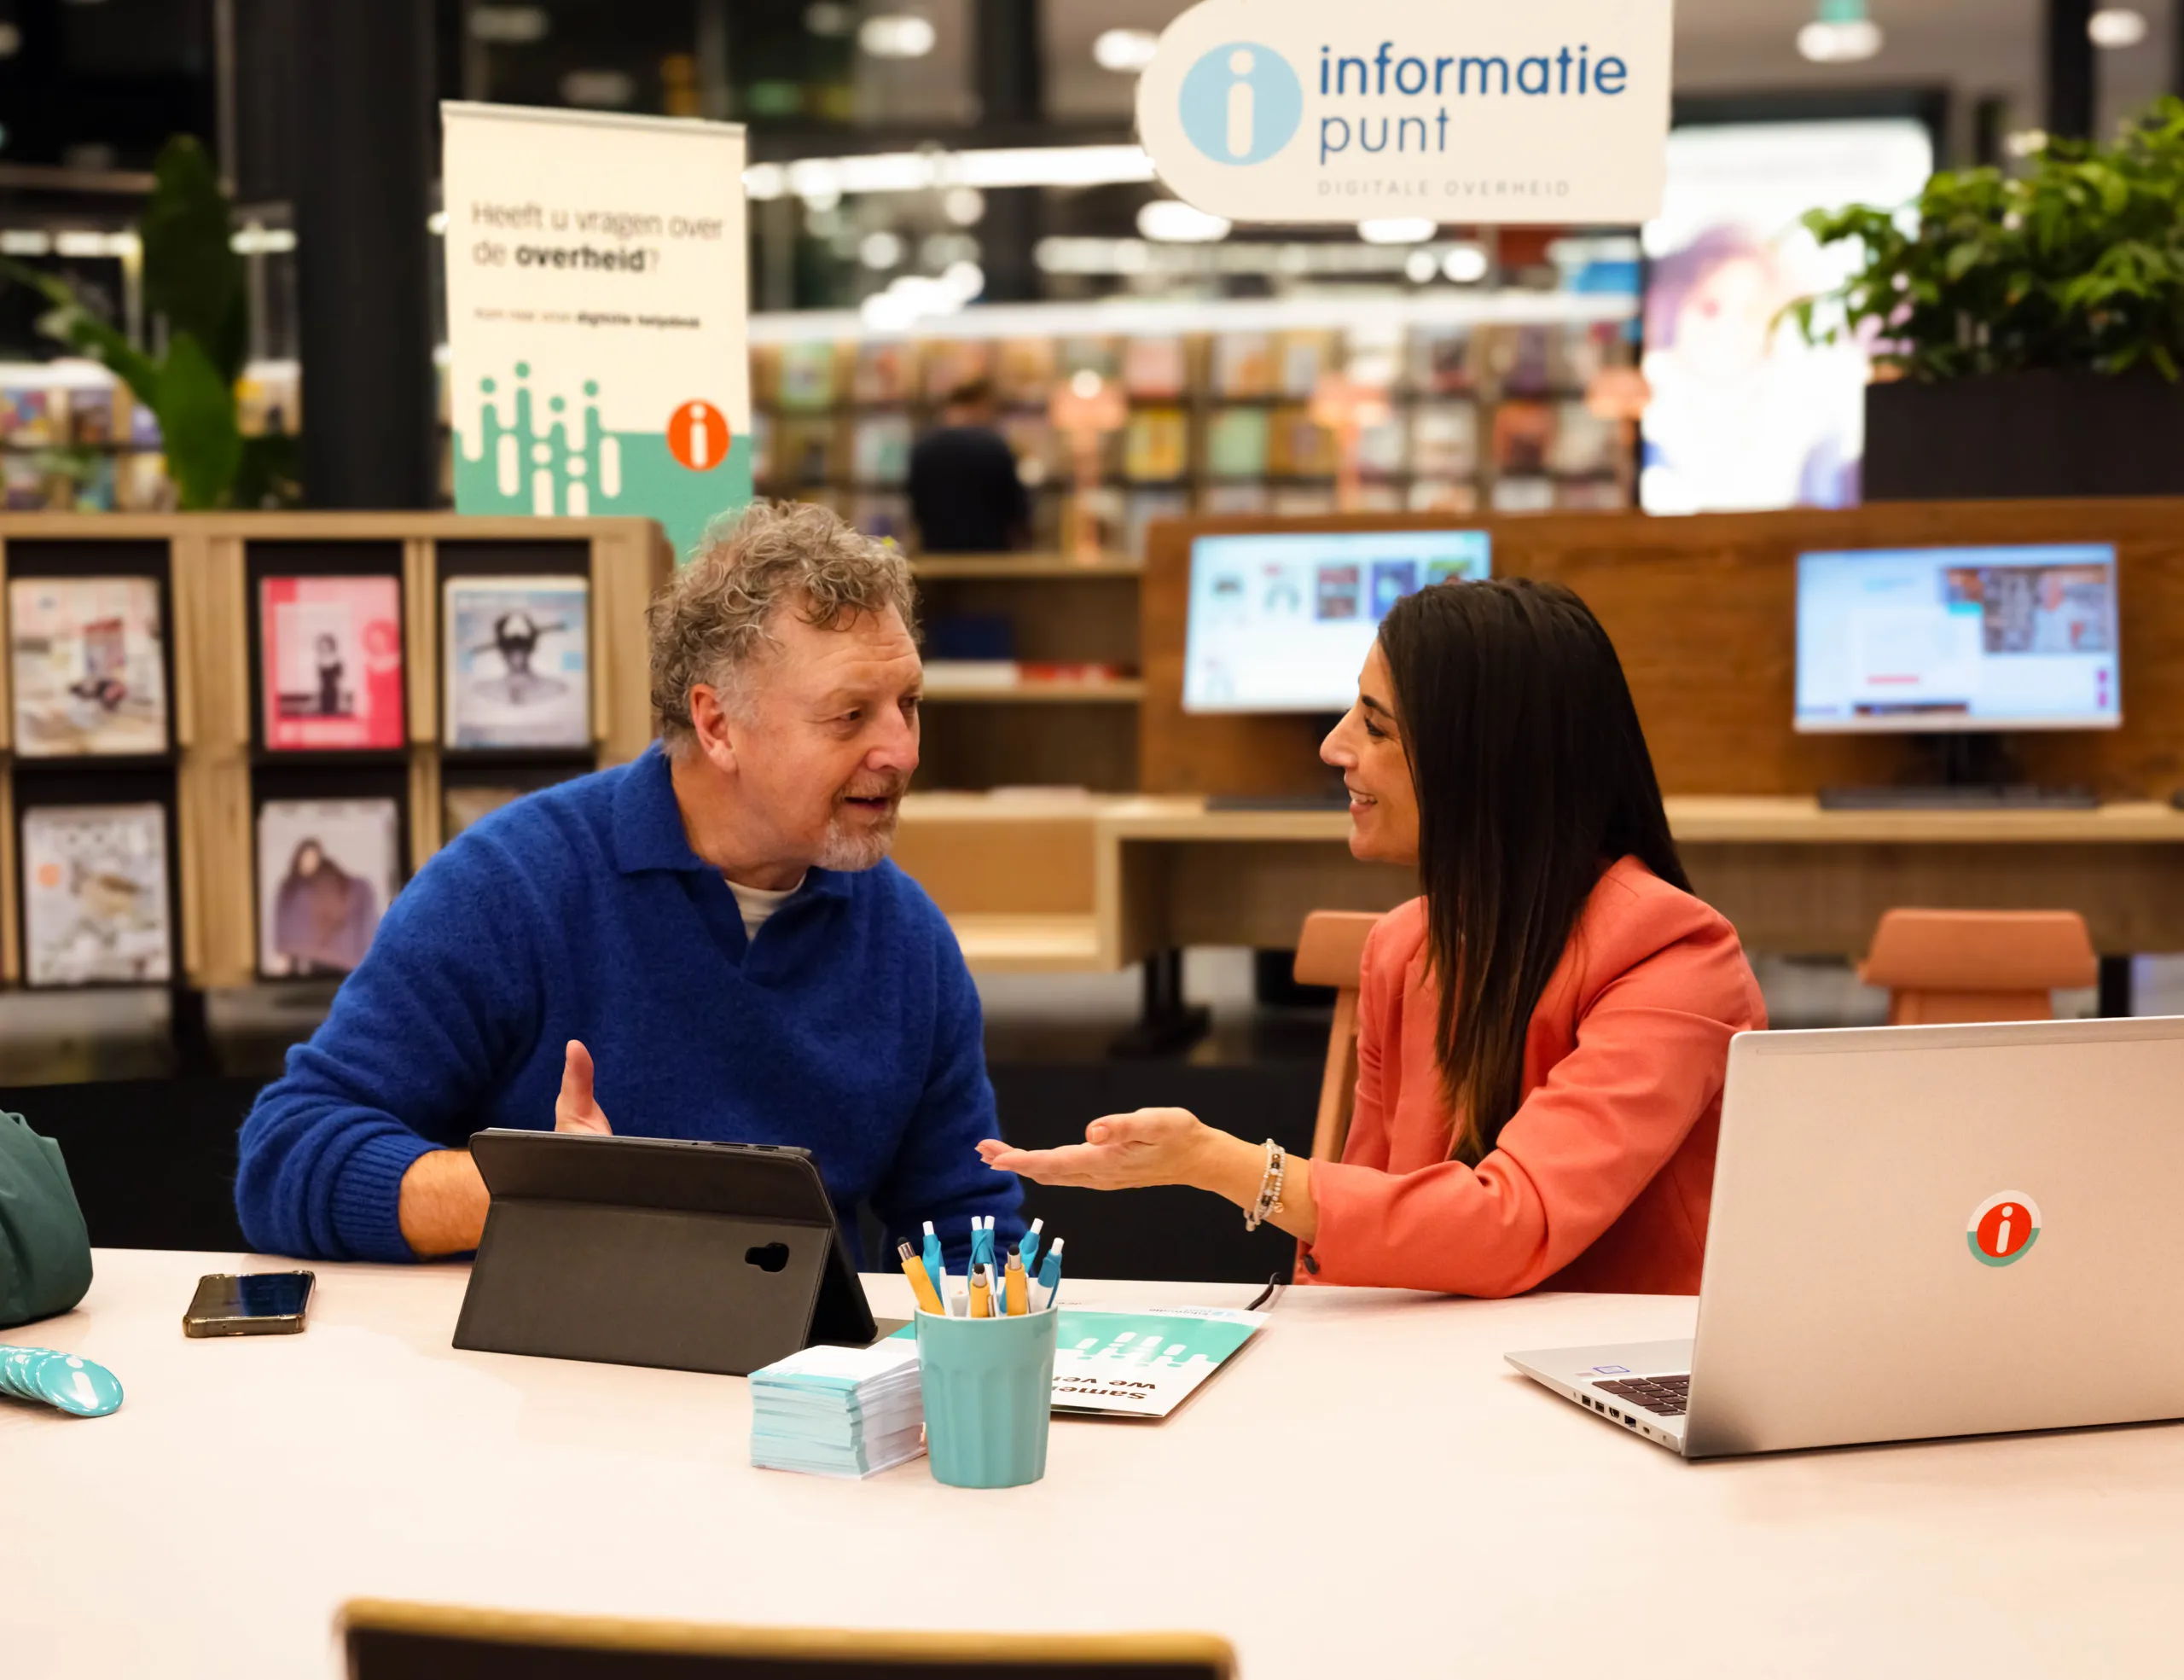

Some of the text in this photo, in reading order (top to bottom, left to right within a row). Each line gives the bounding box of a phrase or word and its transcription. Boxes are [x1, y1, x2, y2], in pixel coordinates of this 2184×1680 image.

[1319, 41, 1629, 96] informatie
[1319, 106, 1451, 166] punt
[1316, 178, 1571, 197] DIGITALE OVERHEID
[471, 201, 723, 241] Heeft u vragen over
[472, 240, 661, 274] de overheid?
[1108, 1380, 1156, 1390] we
